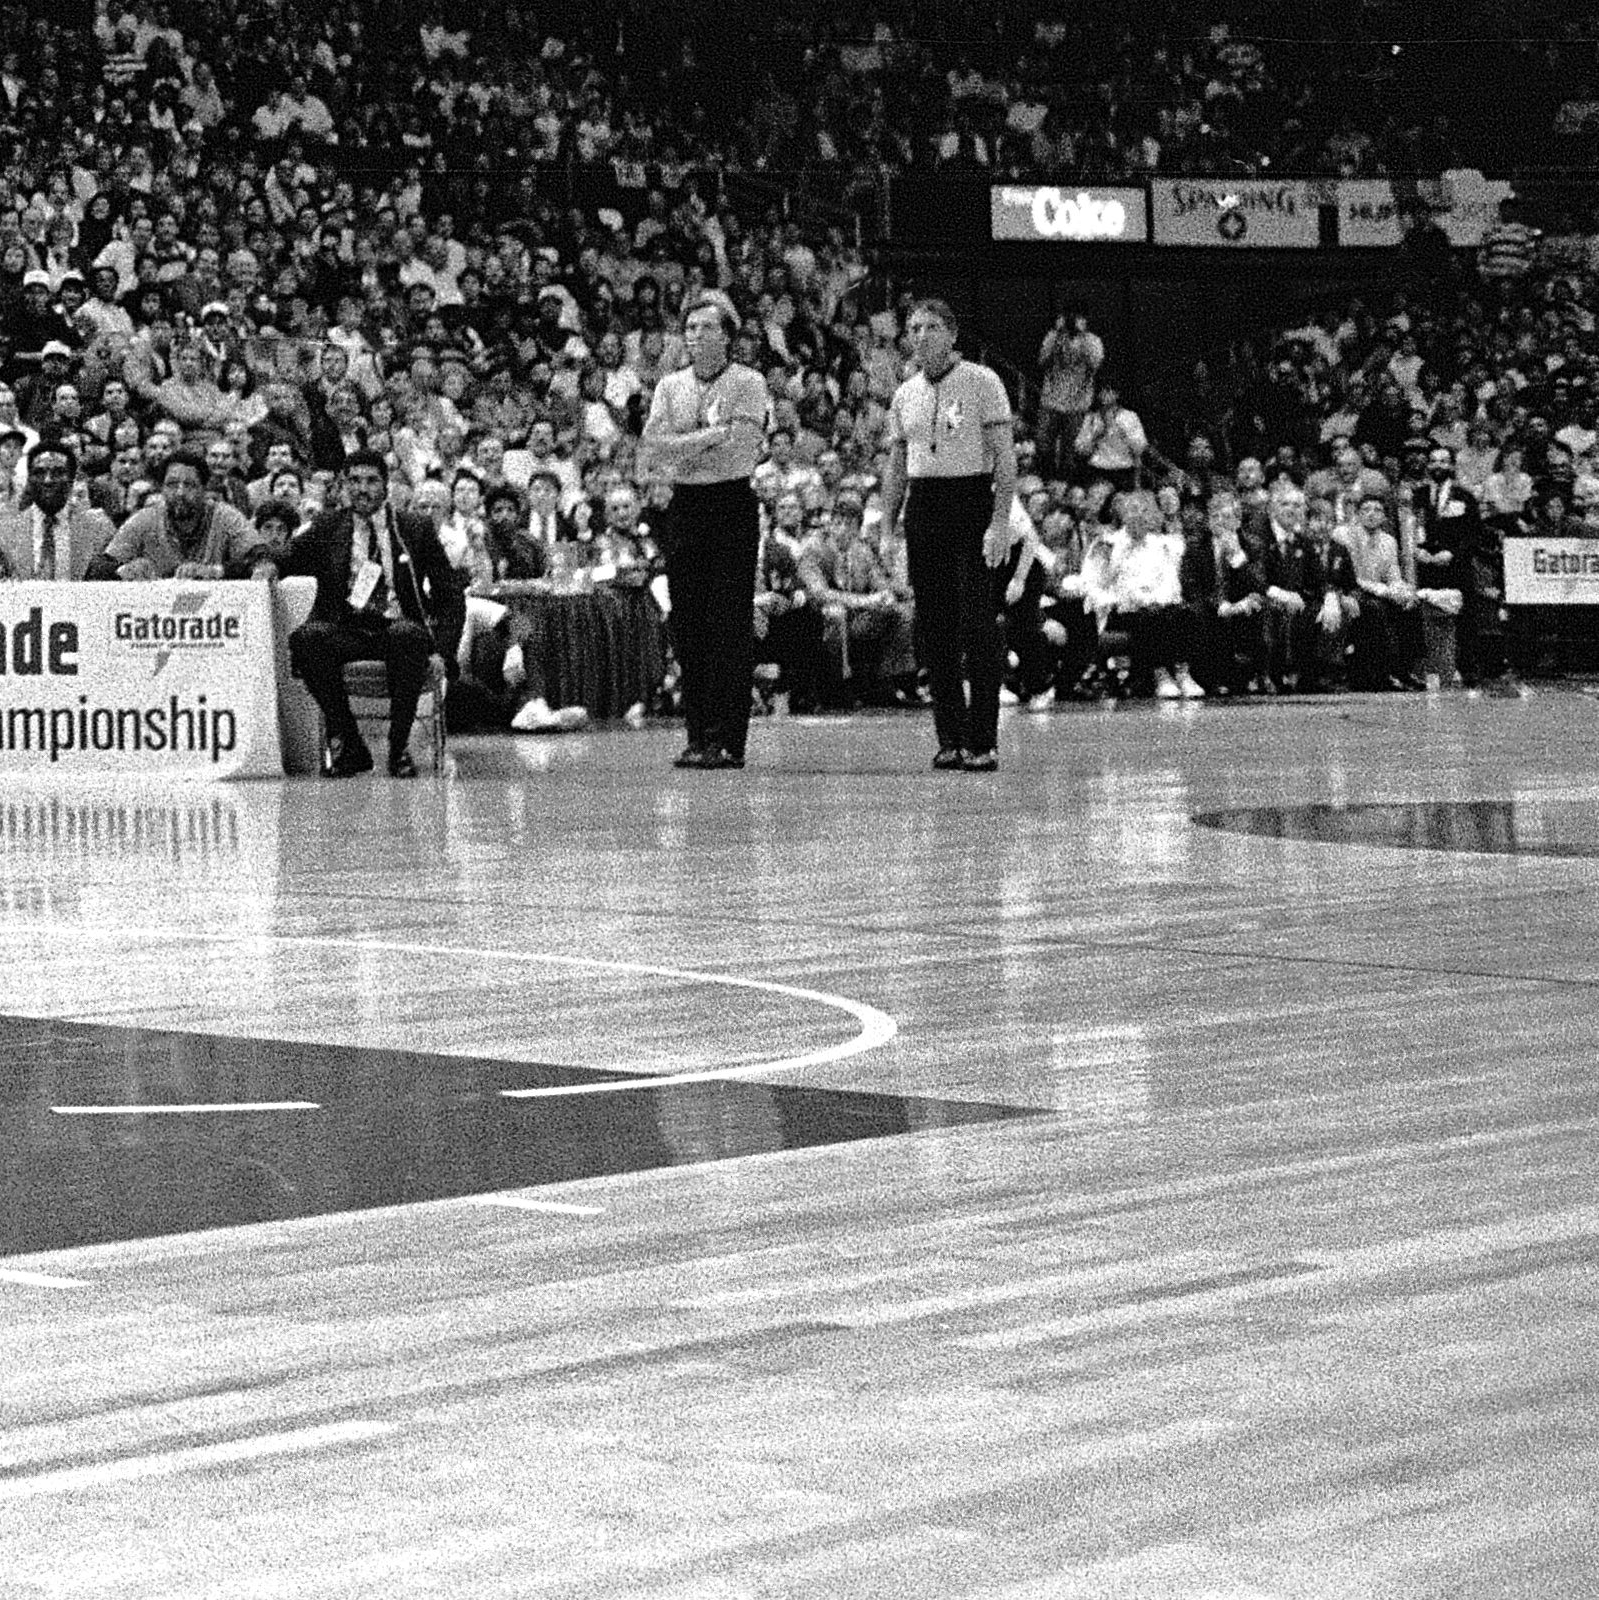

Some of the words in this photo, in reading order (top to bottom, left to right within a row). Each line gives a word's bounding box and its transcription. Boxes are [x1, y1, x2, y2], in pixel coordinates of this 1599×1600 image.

[1031, 186, 1127, 240] Coke
[1171, 183, 1297, 217] SPAING
[115, 611, 240, 640] Gatorade
